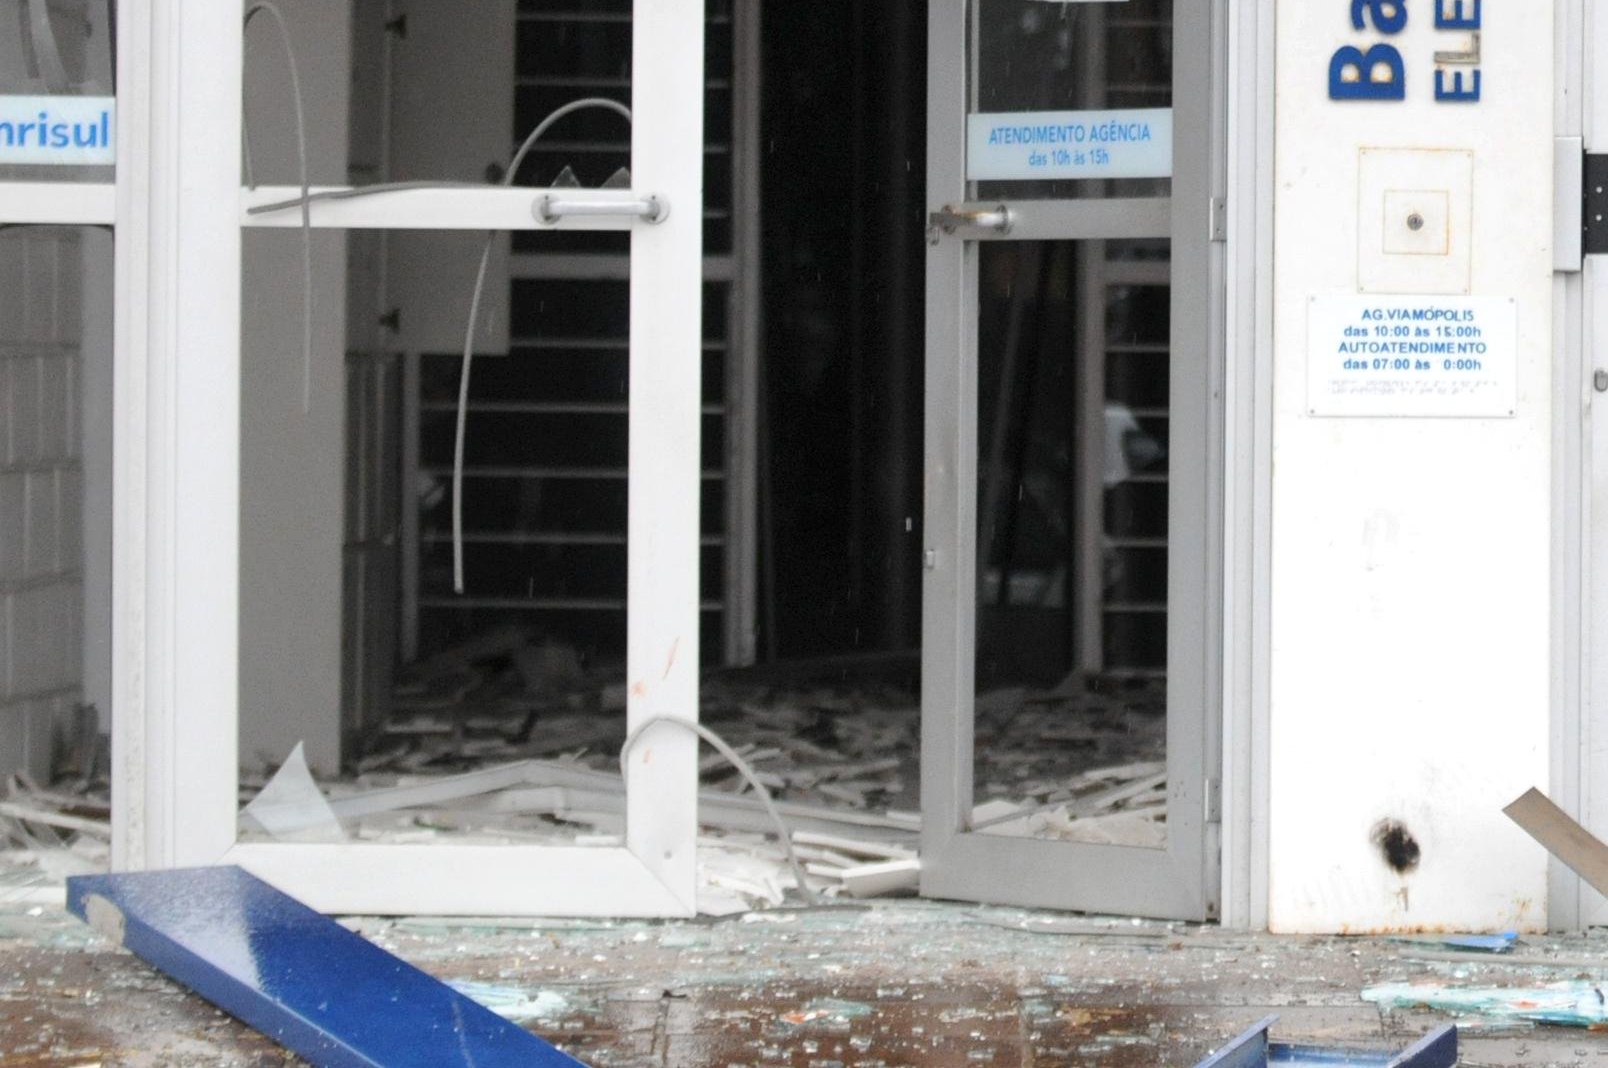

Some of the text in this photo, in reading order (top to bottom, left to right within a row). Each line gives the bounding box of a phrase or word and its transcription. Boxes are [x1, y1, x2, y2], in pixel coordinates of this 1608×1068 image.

[988, 120, 1151, 145] ATENDIMENTO AGÊNCIA
[1028, 150, 1048, 166] das
[1051, 149, 1070, 166] 10h
[1089, 149, 1109, 165] 15h
[1343, 325, 1481, 338] das 10:00 às 15:00h
[1338, 341, 1487, 354] AUTOATENDIMENTO
[1343, 358, 1368, 370] das
[1372, 358, 1410, 370] 07:00
[1414, 358, 1431, 370] às
